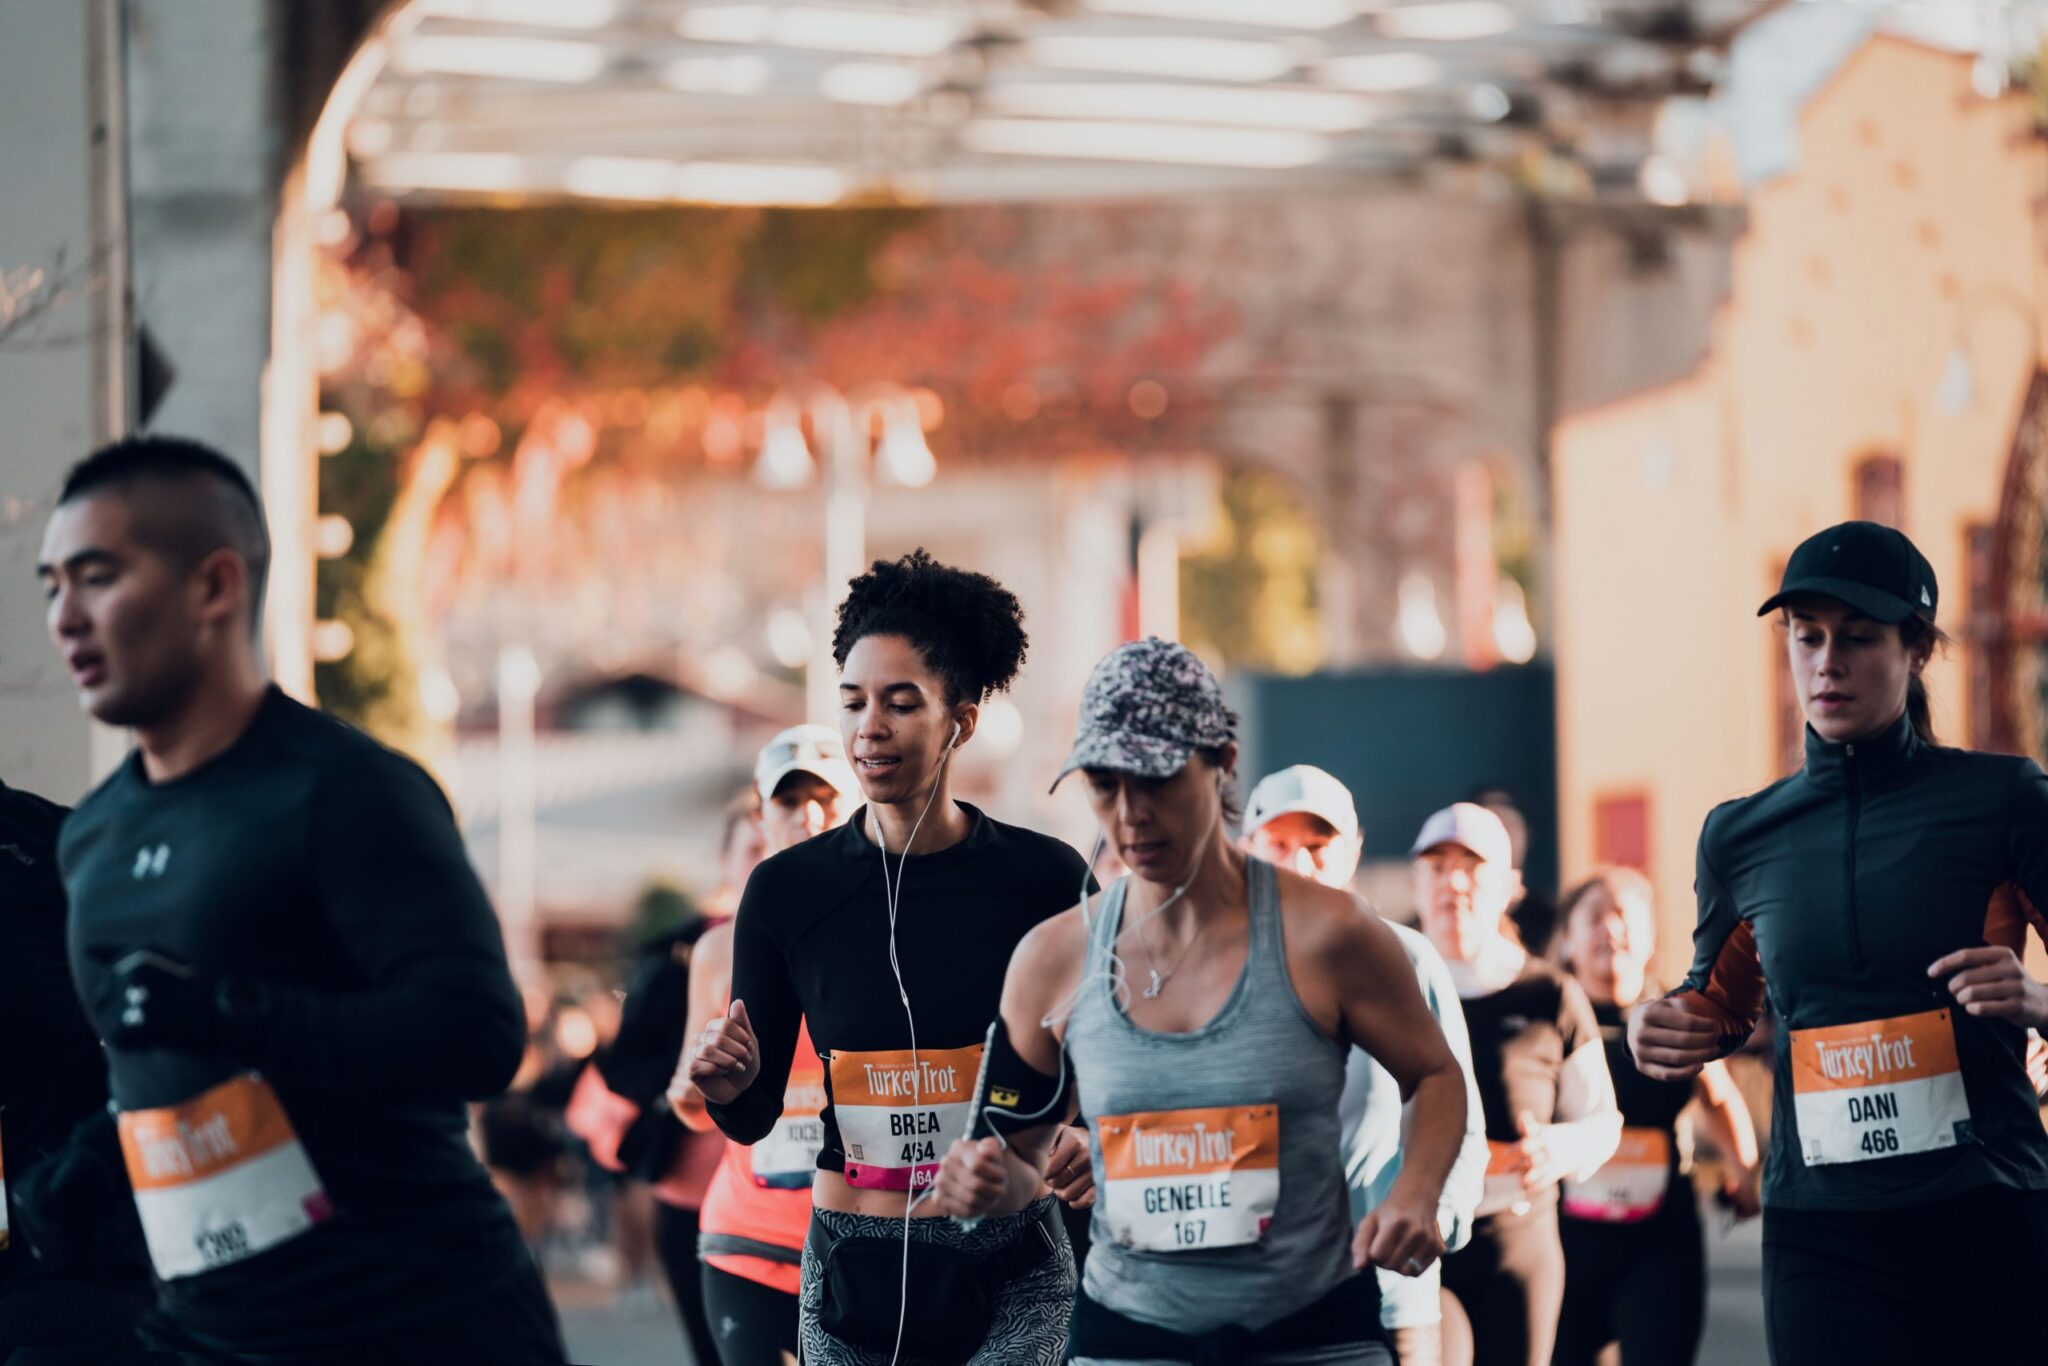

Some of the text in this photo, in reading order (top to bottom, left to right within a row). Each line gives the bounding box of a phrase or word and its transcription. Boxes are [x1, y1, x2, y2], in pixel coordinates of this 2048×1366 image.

[1848, 1092, 1899, 1123] DANI
[890, 1111, 941, 1136] BREA
[901, 1141, 936, 1163] 464
[1861, 1128, 1899, 1154] 466
[1144, 1181, 1232, 1214] GENELLE
[1175, 1220, 1207, 1245] 167
